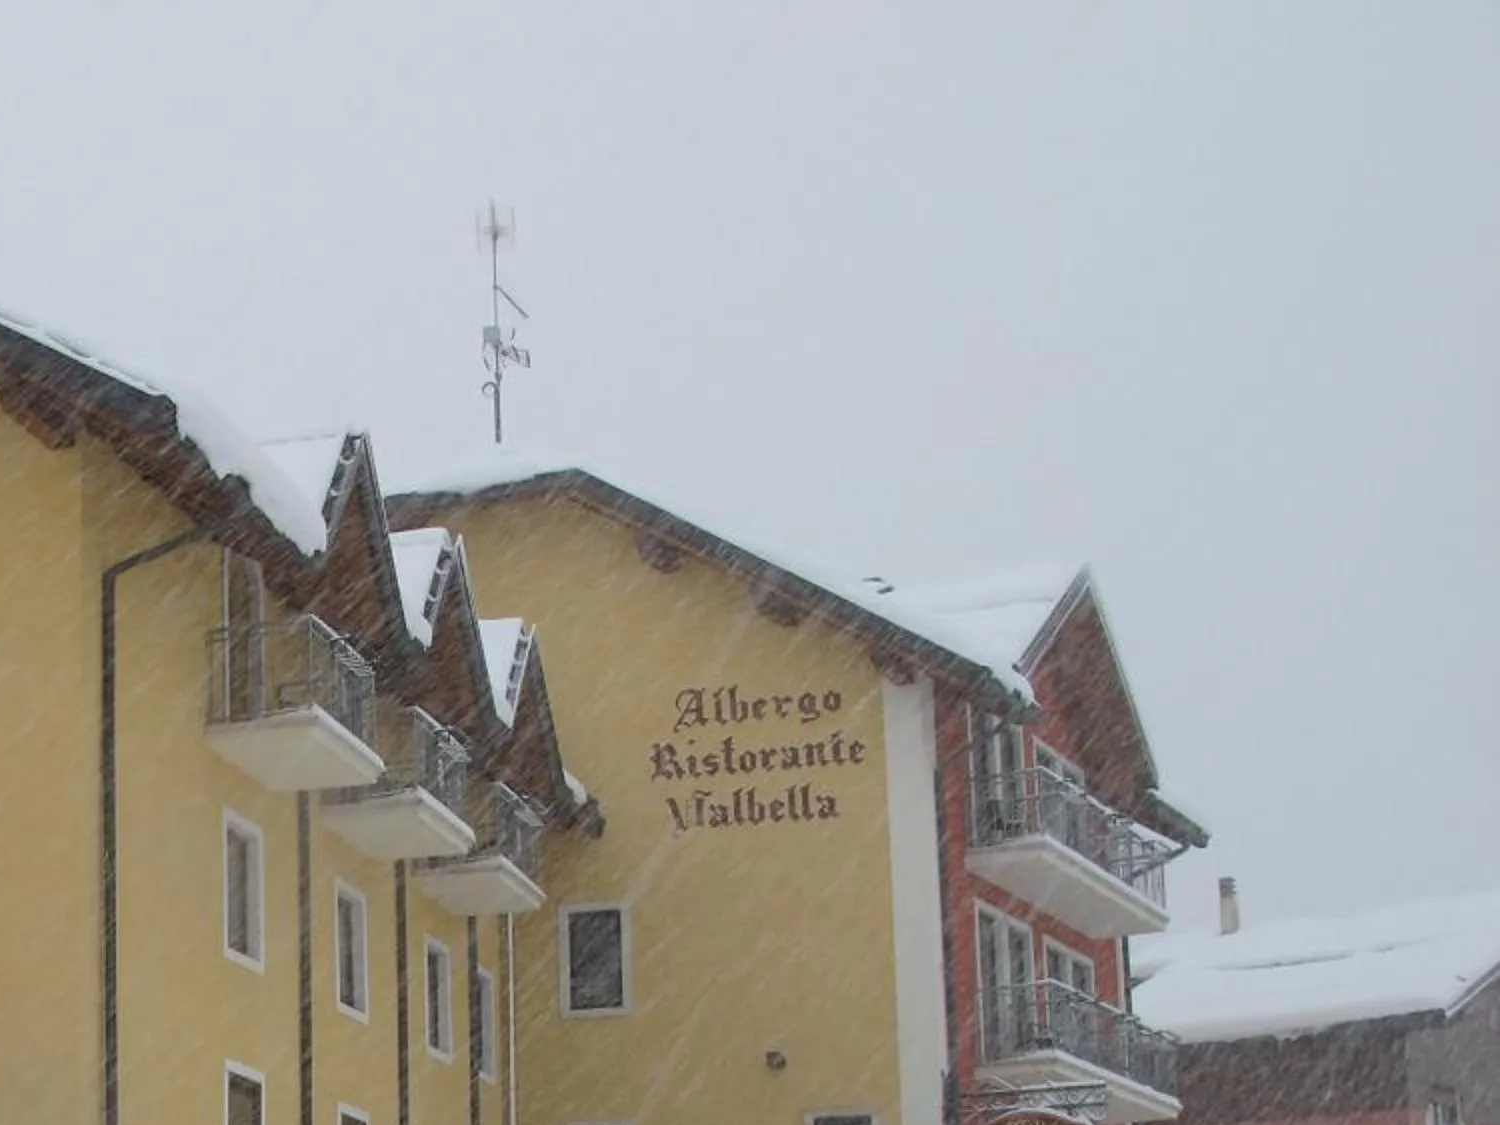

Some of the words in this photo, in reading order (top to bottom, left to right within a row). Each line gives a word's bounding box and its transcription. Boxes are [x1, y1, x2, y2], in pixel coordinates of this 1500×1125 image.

[673, 683, 842, 733] Albergo
[650, 732, 866, 781] Ristorante
[665, 783, 840, 833] Valbella
